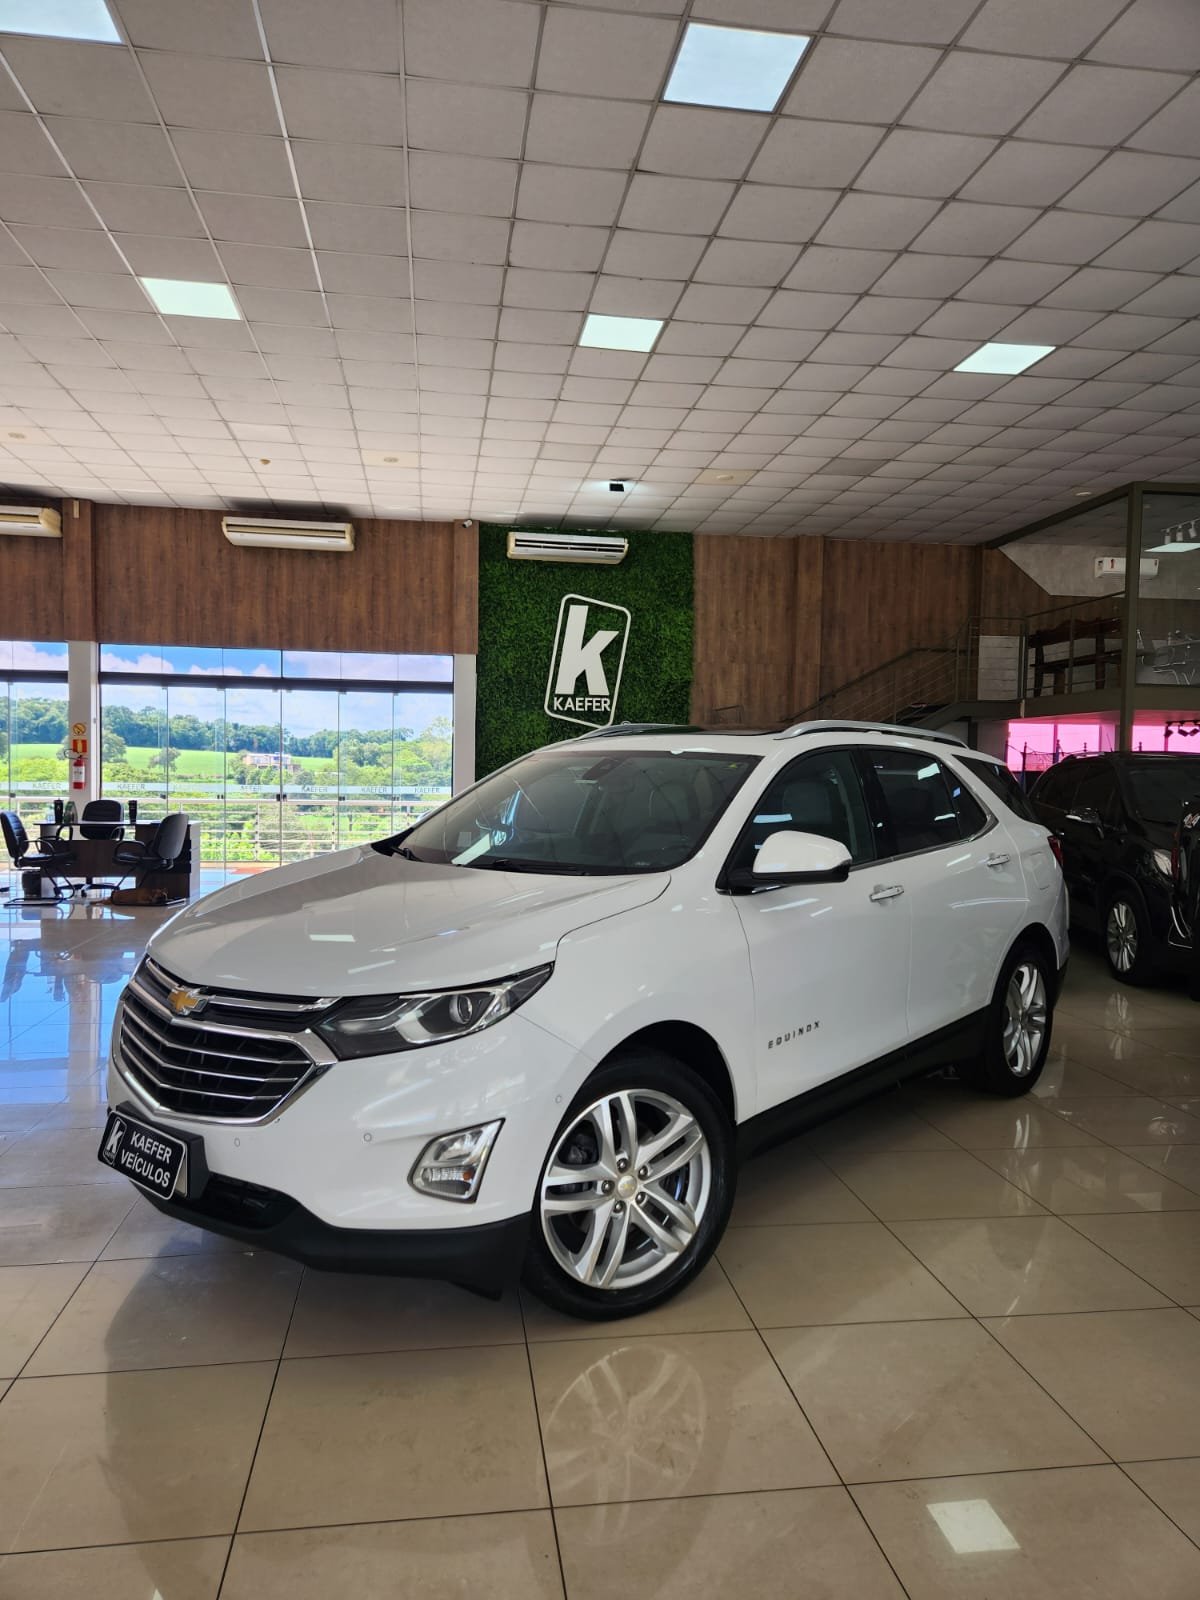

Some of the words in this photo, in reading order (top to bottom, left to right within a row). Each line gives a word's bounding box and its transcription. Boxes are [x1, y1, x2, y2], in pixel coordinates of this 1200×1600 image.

[553, 697, 611, 711] KAEFER
[767, 1021, 820, 1049] EQUINOX
[130, 1131, 172, 1164] KAEFER
[121, 1149, 171, 1187] VEÍCULOS
